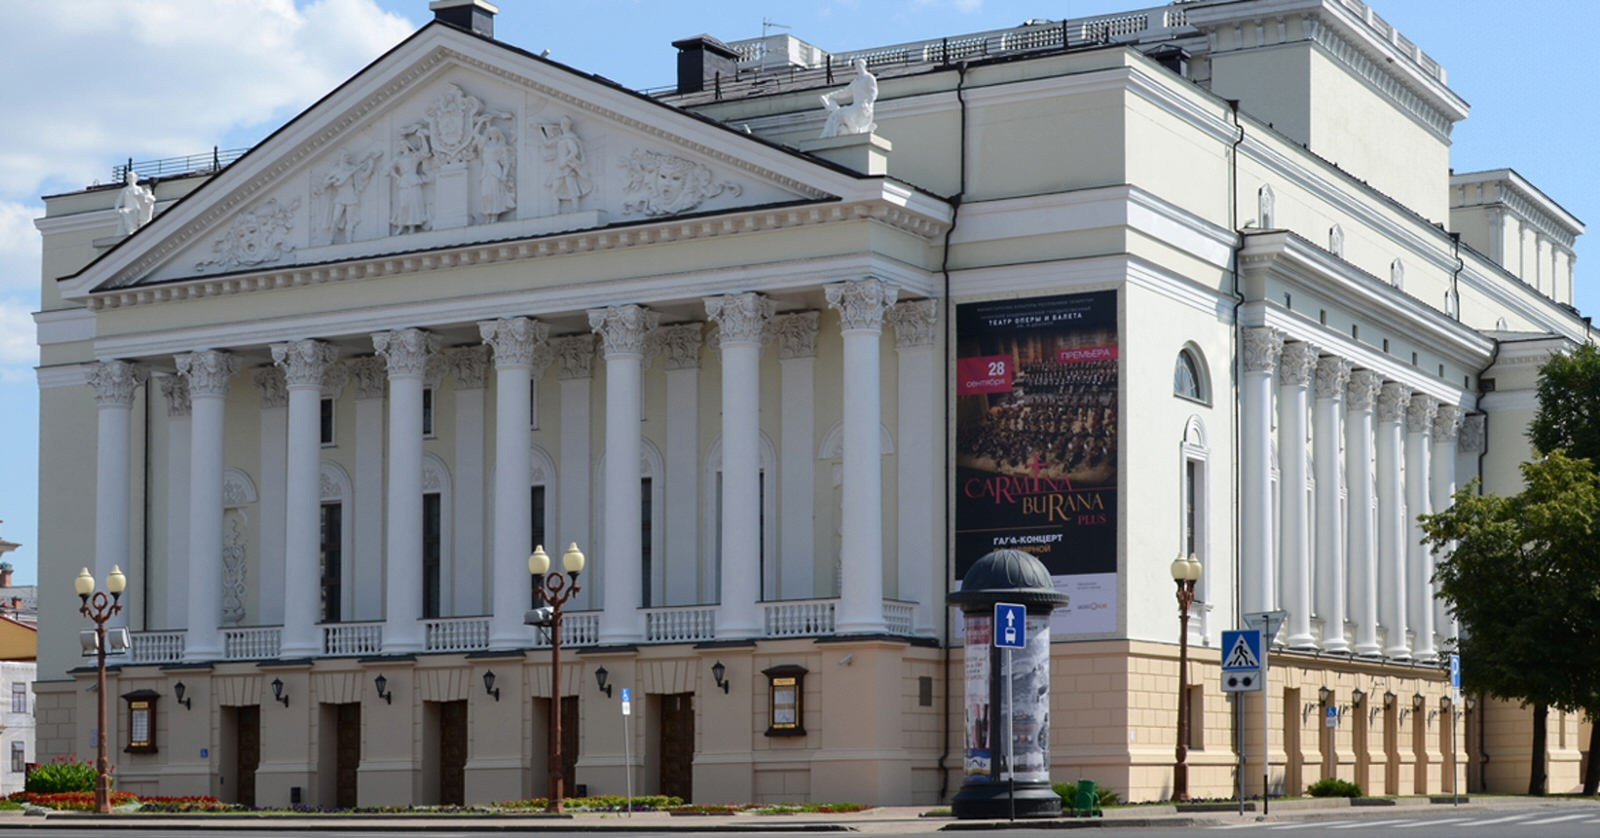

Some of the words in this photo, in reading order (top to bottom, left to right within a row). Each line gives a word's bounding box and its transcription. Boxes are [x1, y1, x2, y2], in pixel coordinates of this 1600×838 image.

[988, 318, 1012, 327] ТЕАТР
[1014, 315, 1042, 325] ОПЕРЫ
[1044, 314, 1050, 322] И
[1052, 312, 1083, 321] БАЛЕТА
[1060, 348, 1111, 361] ПРЕМЬЕРА
[988, 361, 1005, 376] 28
[966, 377, 1006, 388] сентября
[964, 453, 1073, 505] CARMINA
[1077, 514, 1107, 526] PLUS
